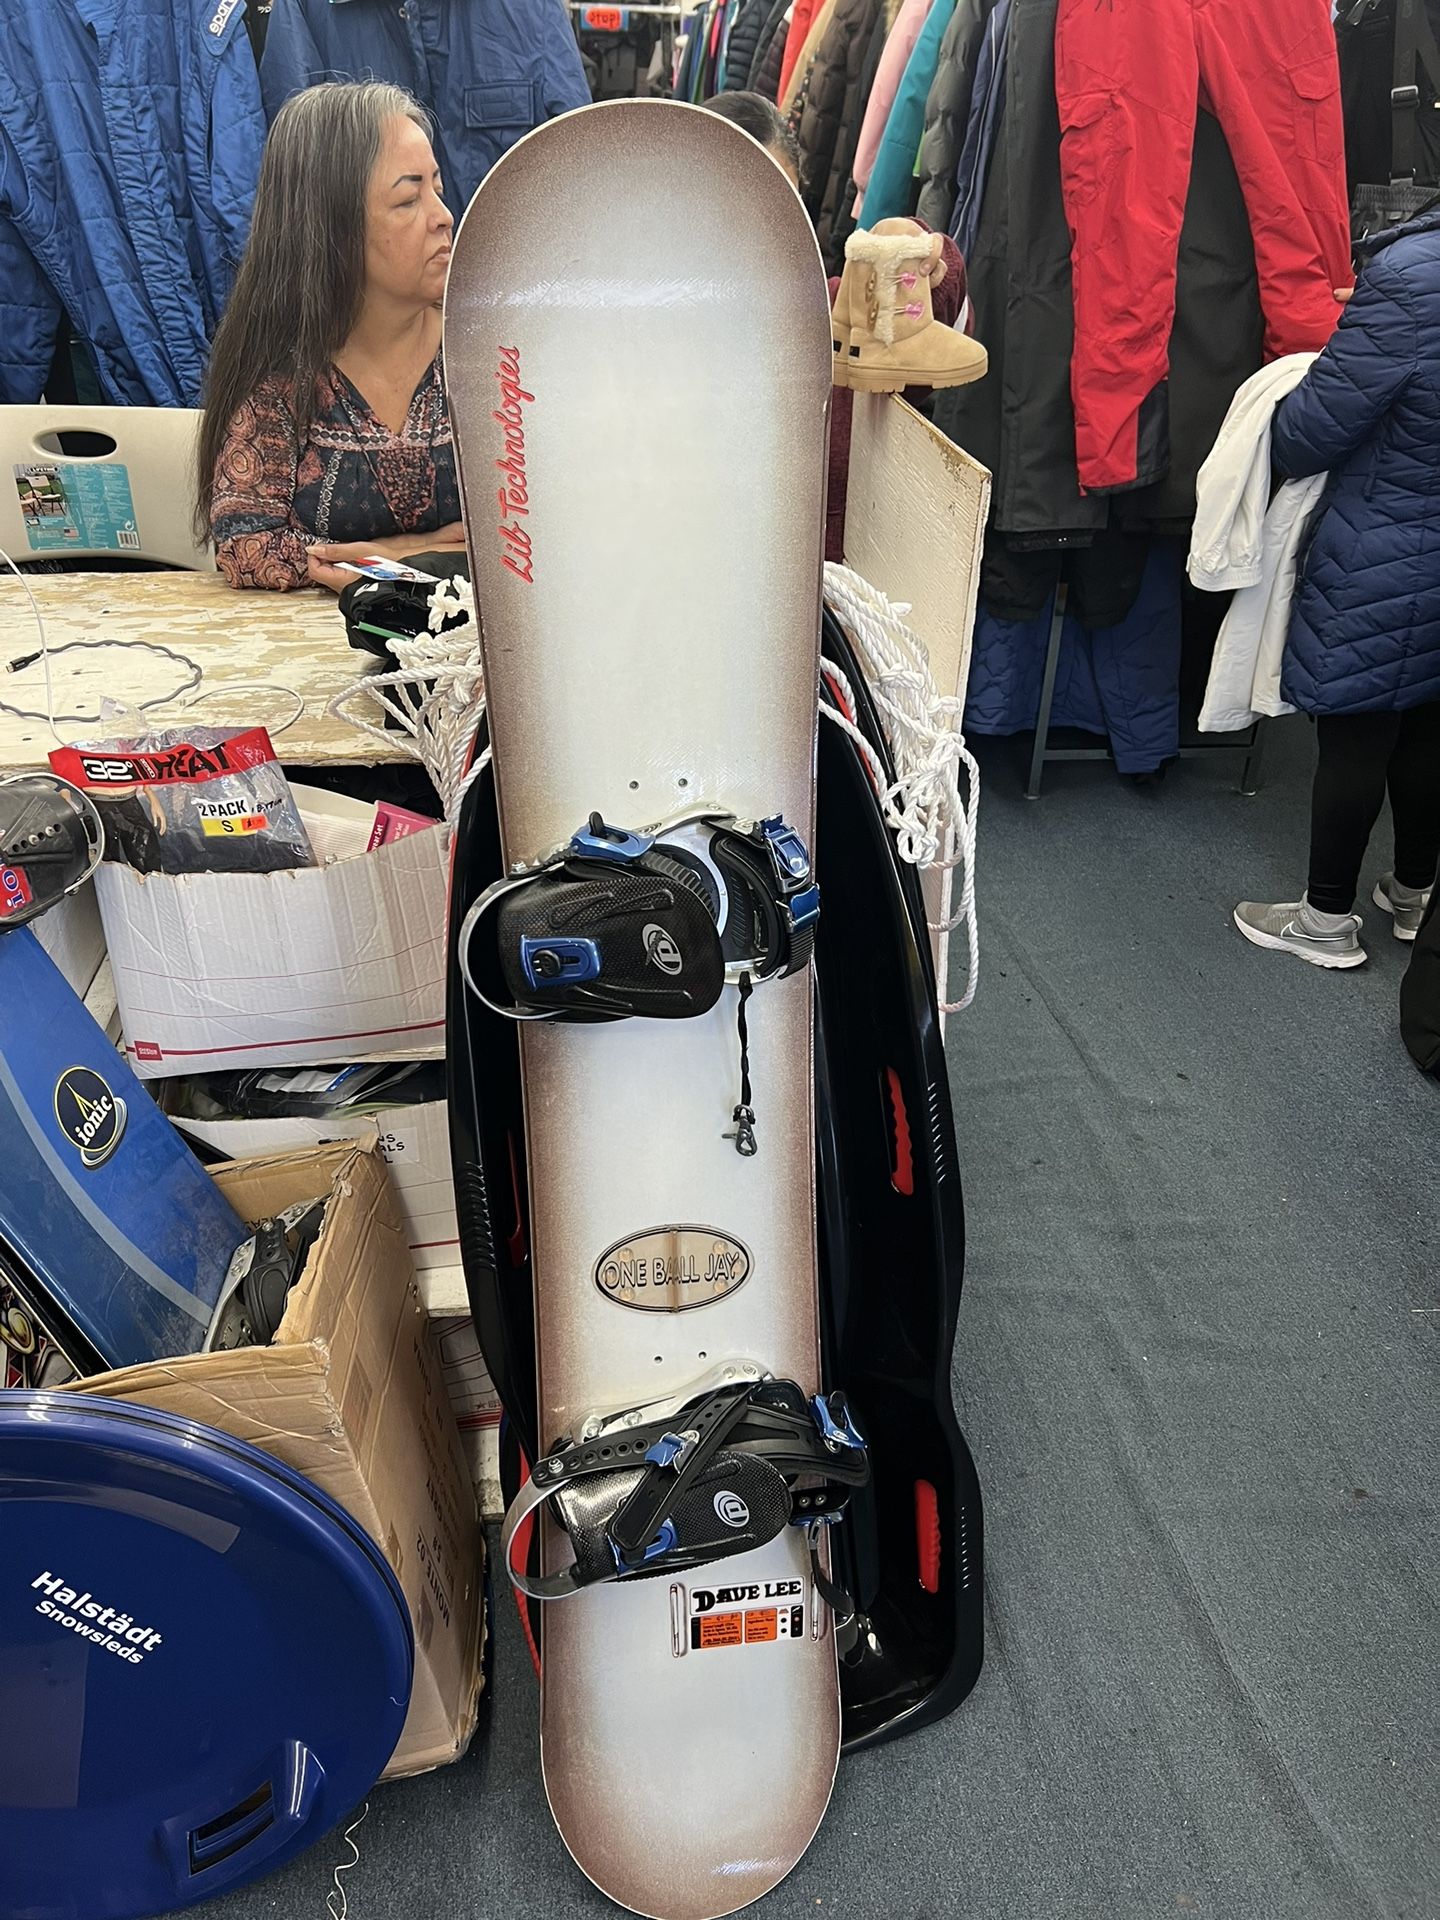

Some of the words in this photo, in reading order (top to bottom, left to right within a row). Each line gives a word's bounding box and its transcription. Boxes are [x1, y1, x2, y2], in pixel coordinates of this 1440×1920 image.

[492, 345, 535, 519] Technologies
[497, 521, 534, 583] Lib
[152, 742, 230, 779] HEAT
[221, 820, 235, 833] S
[75, 1095, 113, 1147] ionic
[603, 1259, 647, 1289] ONE
[653, 1254, 700, 1286] BALL
[704, 1251, 740, 1281] JAY
[31, 1571, 162, 1652] Halstädt
[427, 1559, 450, 1629] MONTE
[692, 1584, 760, 1612] DAVE
[765, 1580, 802, 1598] LEE
[35, 1600, 144, 1664] snowsleds
